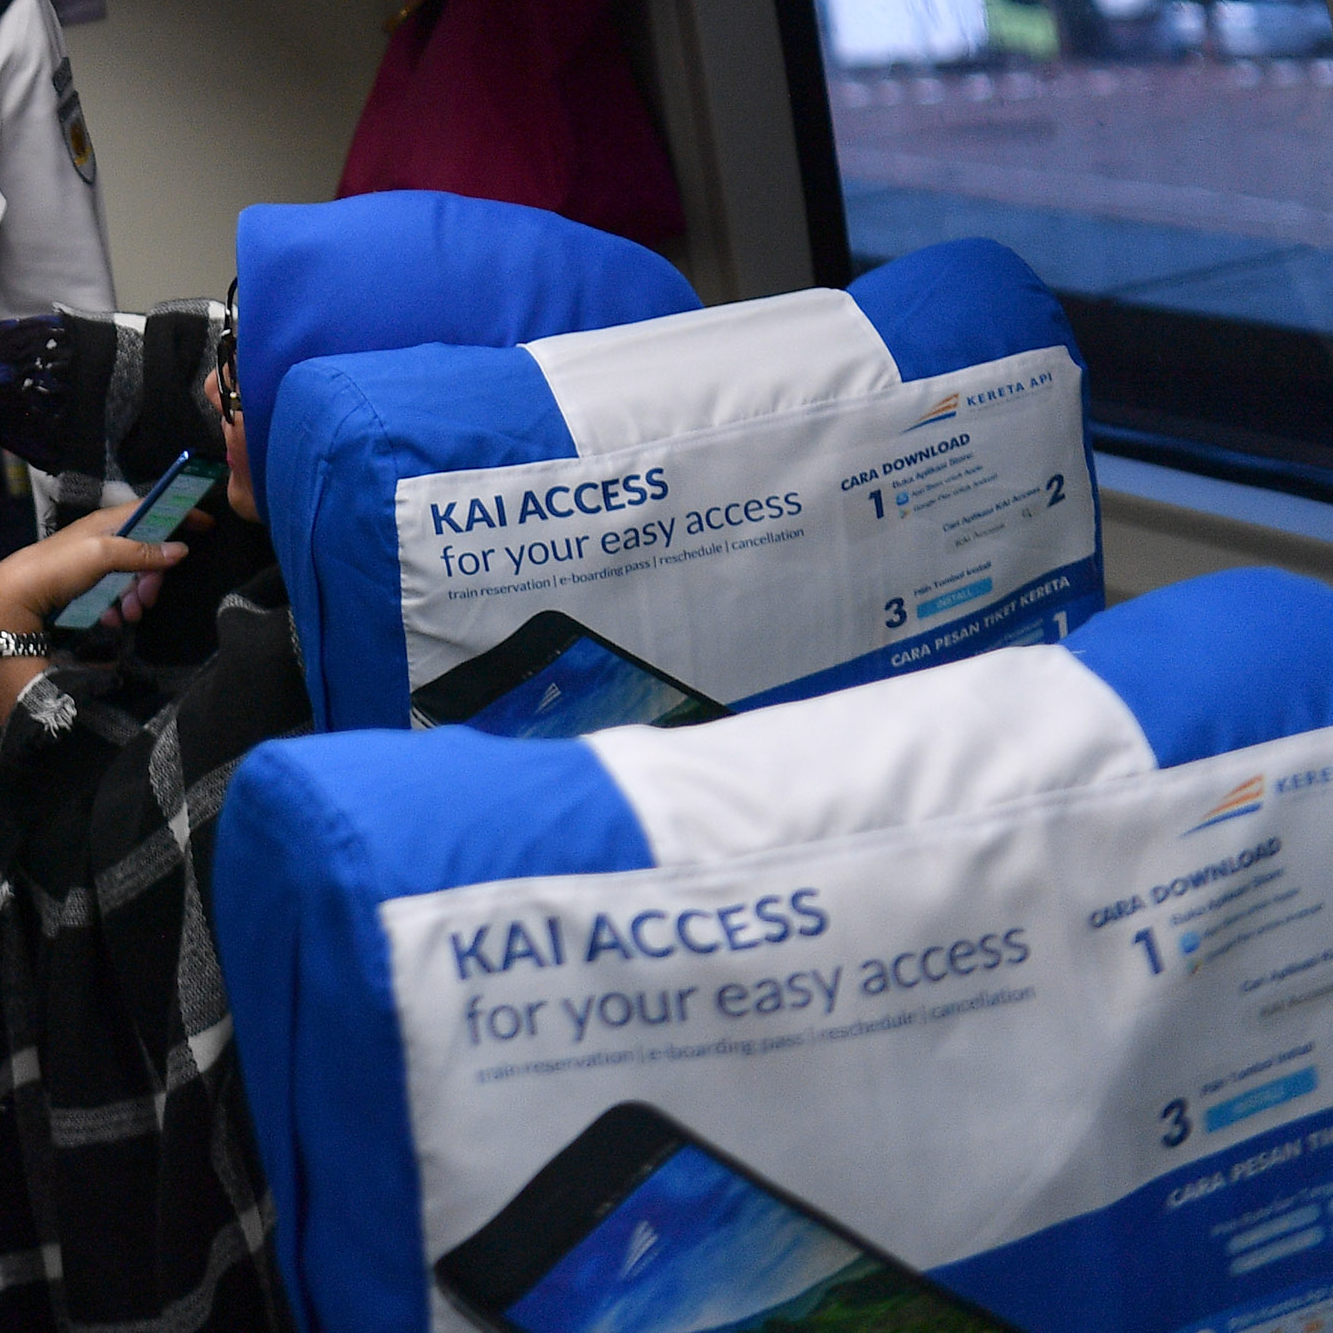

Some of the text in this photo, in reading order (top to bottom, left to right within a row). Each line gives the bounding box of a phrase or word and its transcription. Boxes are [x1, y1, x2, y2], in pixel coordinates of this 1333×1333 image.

[966, 381, 1025, 407] KERETA
[1029, 372, 1054, 389] API
[840, 467, 879, 492] CARA
[882, 432, 971, 477] DOWNLOAD
[430, 467, 670, 535] KAI ACCESS
[868, 488, 885, 520] 1
[1045, 472, 1067, 509] 2
[440, 490, 804, 578] for your easy access
[448, 527, 806, 600] train reservation e-boarding pass reschedule cancellation
[884, 596, 908, 629] 3
[891, 642, 932, 668] CARA
[935, 623, 981, 652] PESAN
[984, 602, 1017, 630] TIKET
[1020, 575, 1071, 607] KERETA
[1053, 610, 1068, 640] 1
[449, 887, 831, 981] KAI ACCESS
[1133, 926, 1164, 976] 1
[464, 927, 1033, 1048] for your easy access
[1159, 1097, 1193, 1149] 3
